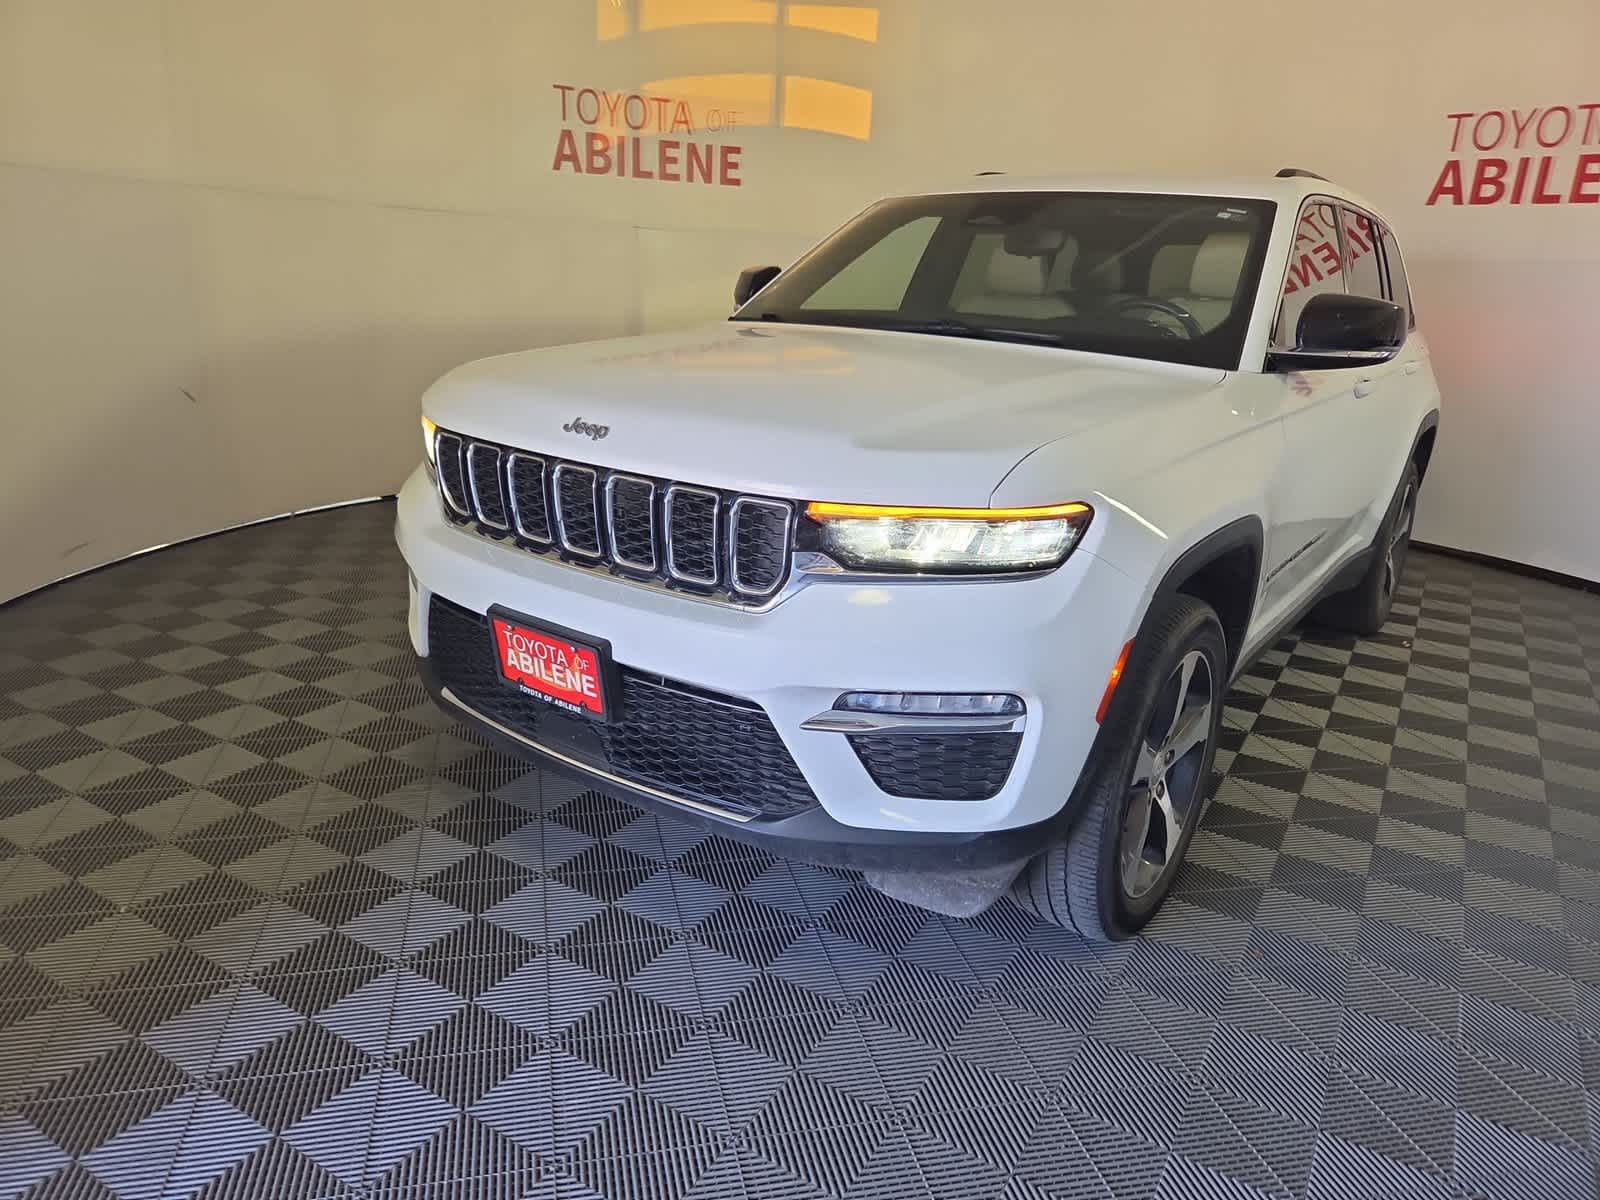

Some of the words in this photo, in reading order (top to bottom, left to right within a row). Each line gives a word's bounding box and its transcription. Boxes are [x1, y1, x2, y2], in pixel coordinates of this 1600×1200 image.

[552, 84, 693, 135] TOYOTA
[705, 108, 738, 132] OF
[1447, 103, 1600, 152] TOYOT
[552, 129, 742, 187] ABILENE
[562, 416, 609, 441] Jeep
[503, 629, 569, 668] TOYOTA
[573, 654, 590, 672] OF
[507, 647, 598, 698] ABILENE
[519, 684, 542, 699] TOYOTA
[543, 694, 553, 703] OF
[554, 699, 582, 714] ABILENE
